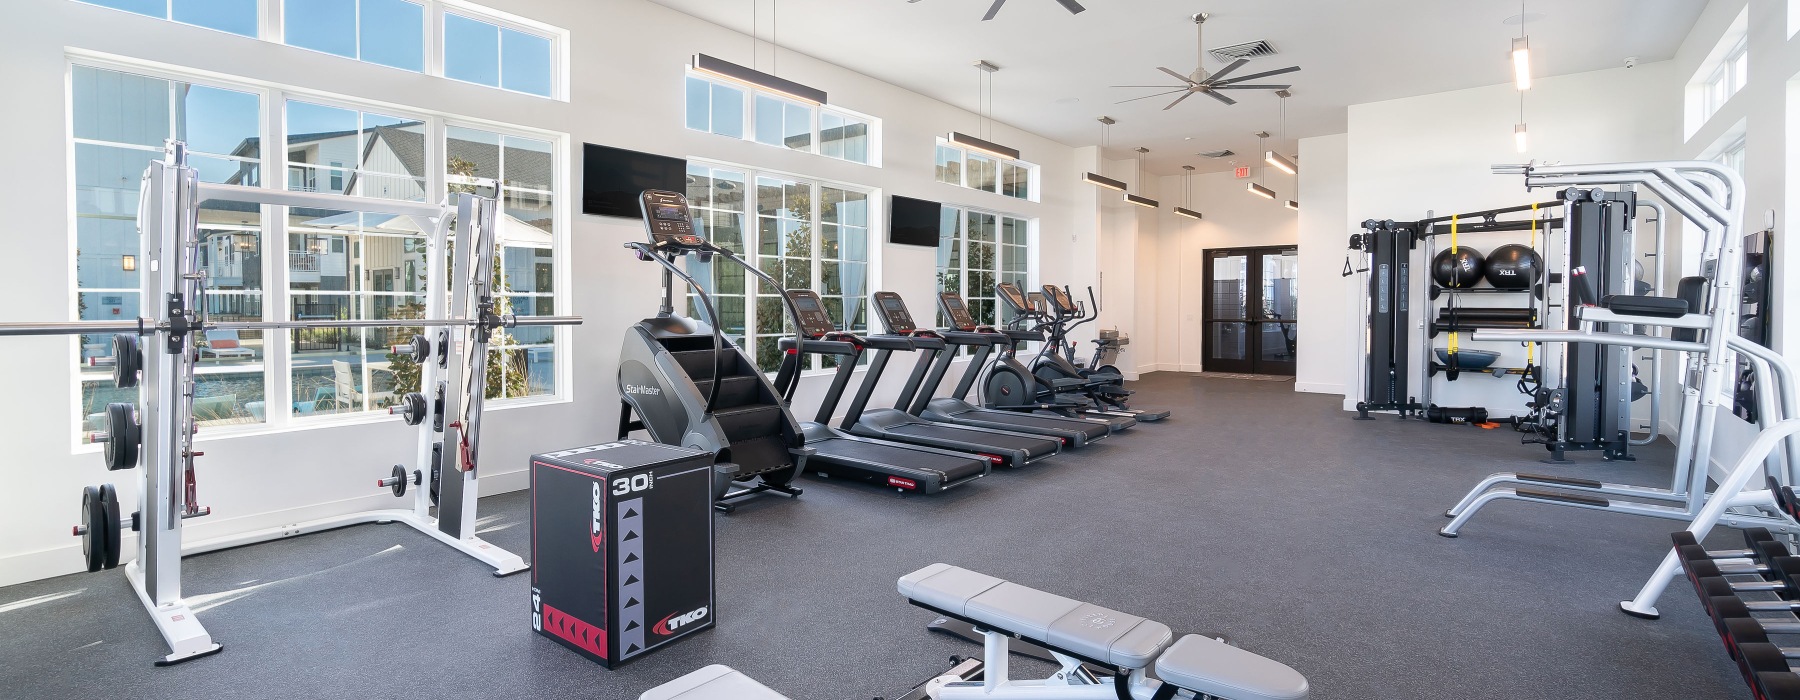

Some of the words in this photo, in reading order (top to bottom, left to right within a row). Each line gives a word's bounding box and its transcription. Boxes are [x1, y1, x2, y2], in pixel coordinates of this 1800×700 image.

[1236, 167, 1248, 176] EXIT
[1460, 258, 1471, 272] TRX
[626, 384, 660, 396] StairMaster
[613, 473, 649, 496] 30
[532, 593, 541, 632] 24
[667, 606, 708, 631] TKO
